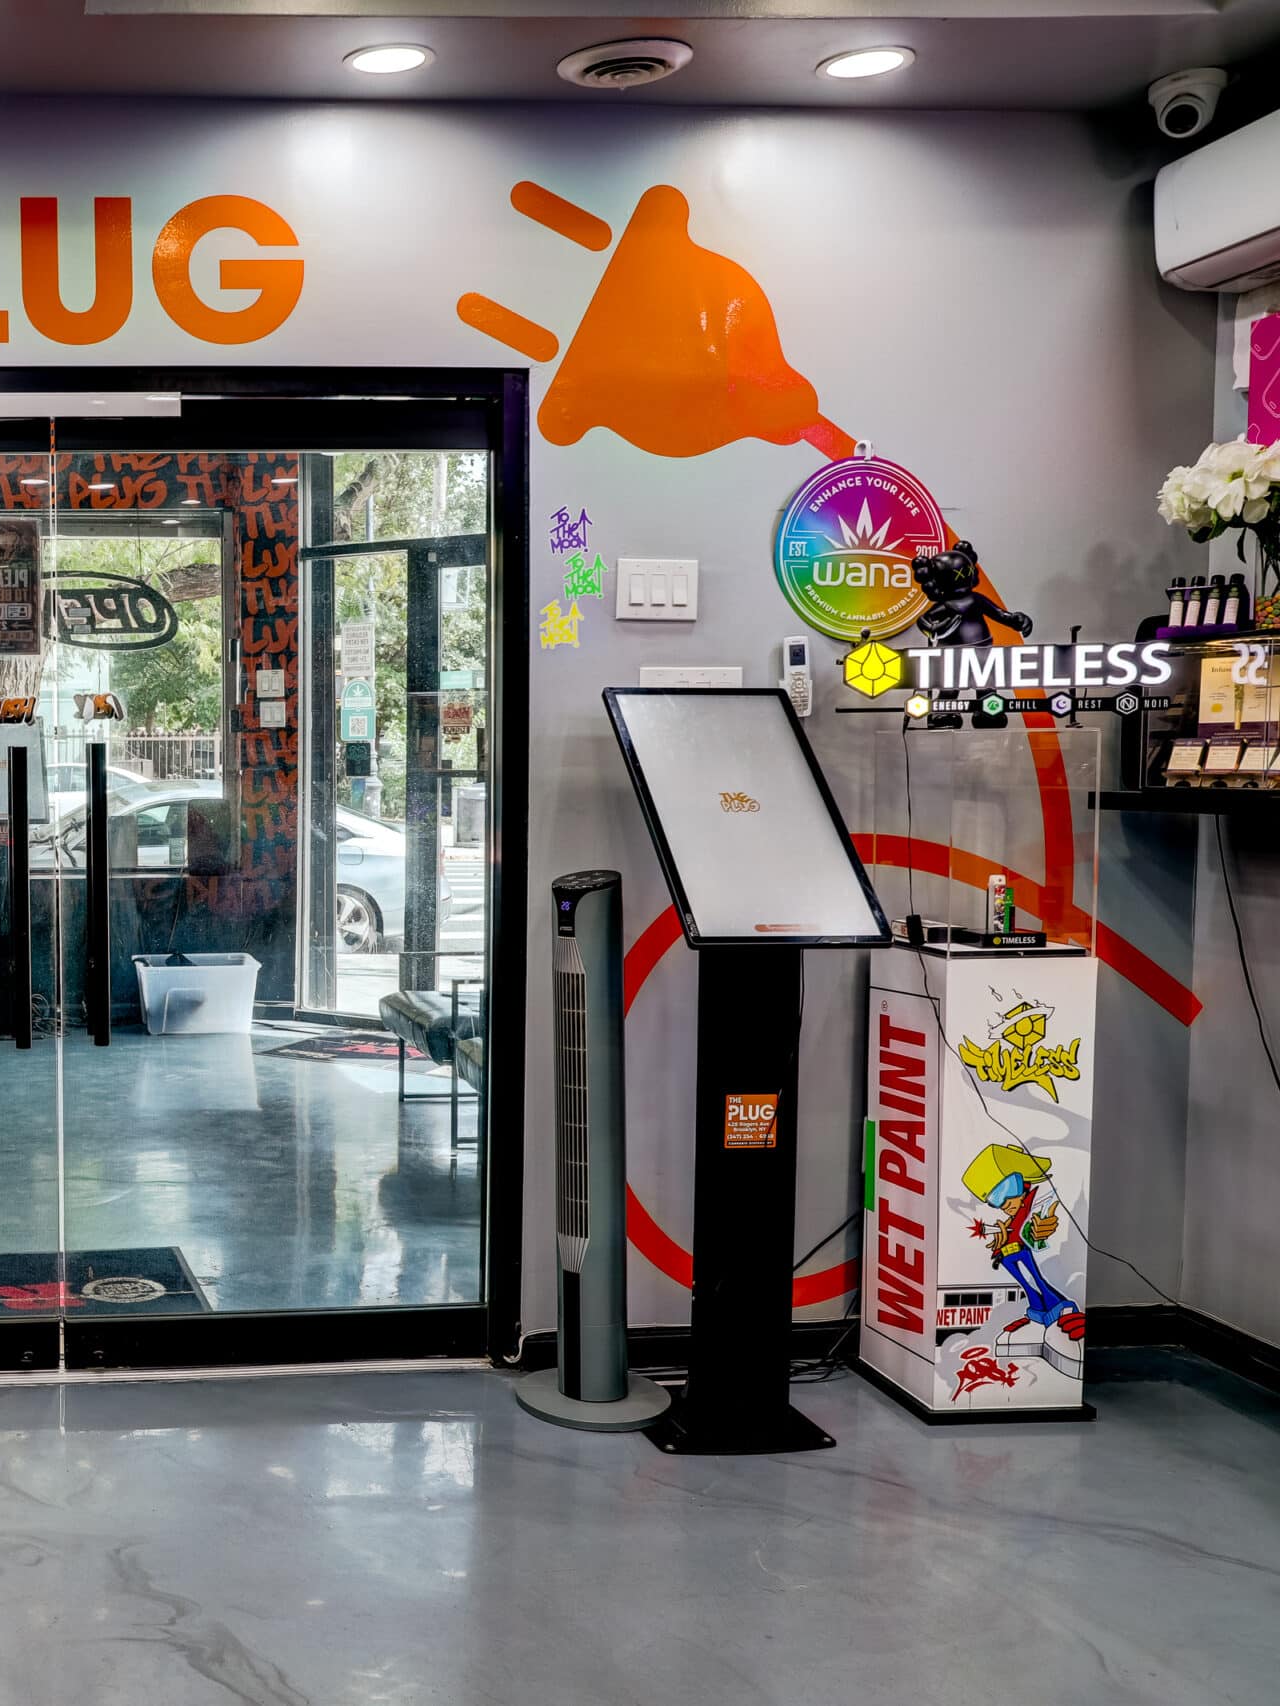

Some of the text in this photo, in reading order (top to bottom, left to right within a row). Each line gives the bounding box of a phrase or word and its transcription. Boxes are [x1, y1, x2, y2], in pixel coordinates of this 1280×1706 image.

[70, 472, 168, 509] PLUG
[809, 476, 921, 517] ENHANCE YOUR LIFE
[550, 506, 570, 524] TO
[789, 541, 809, 557] EST.
[565, 552, 585, 570] TO
[812, 561, 912, 587] wana
[804, 584, 918, 622] PREMIUM CANNABIS EDIBLES
[908, 643, 1171, 689] TIMELESS
[932, 701, 969, 711] ENERGY
[1008, 700, 1037, 710] CHILL
[1078, 700, 1103, 709] REST
[1144, 700, 1169, 708] NOIR
[1002, 936, 1037, 945] TIMELESS
[958, 1034, 1081, 1104] TIMELESS
[728, 1104, 776, 1121] PLUG
[878, 1013, 927, 1335] WET PAINT
[959, 1307, 992, 1325] PAINT
